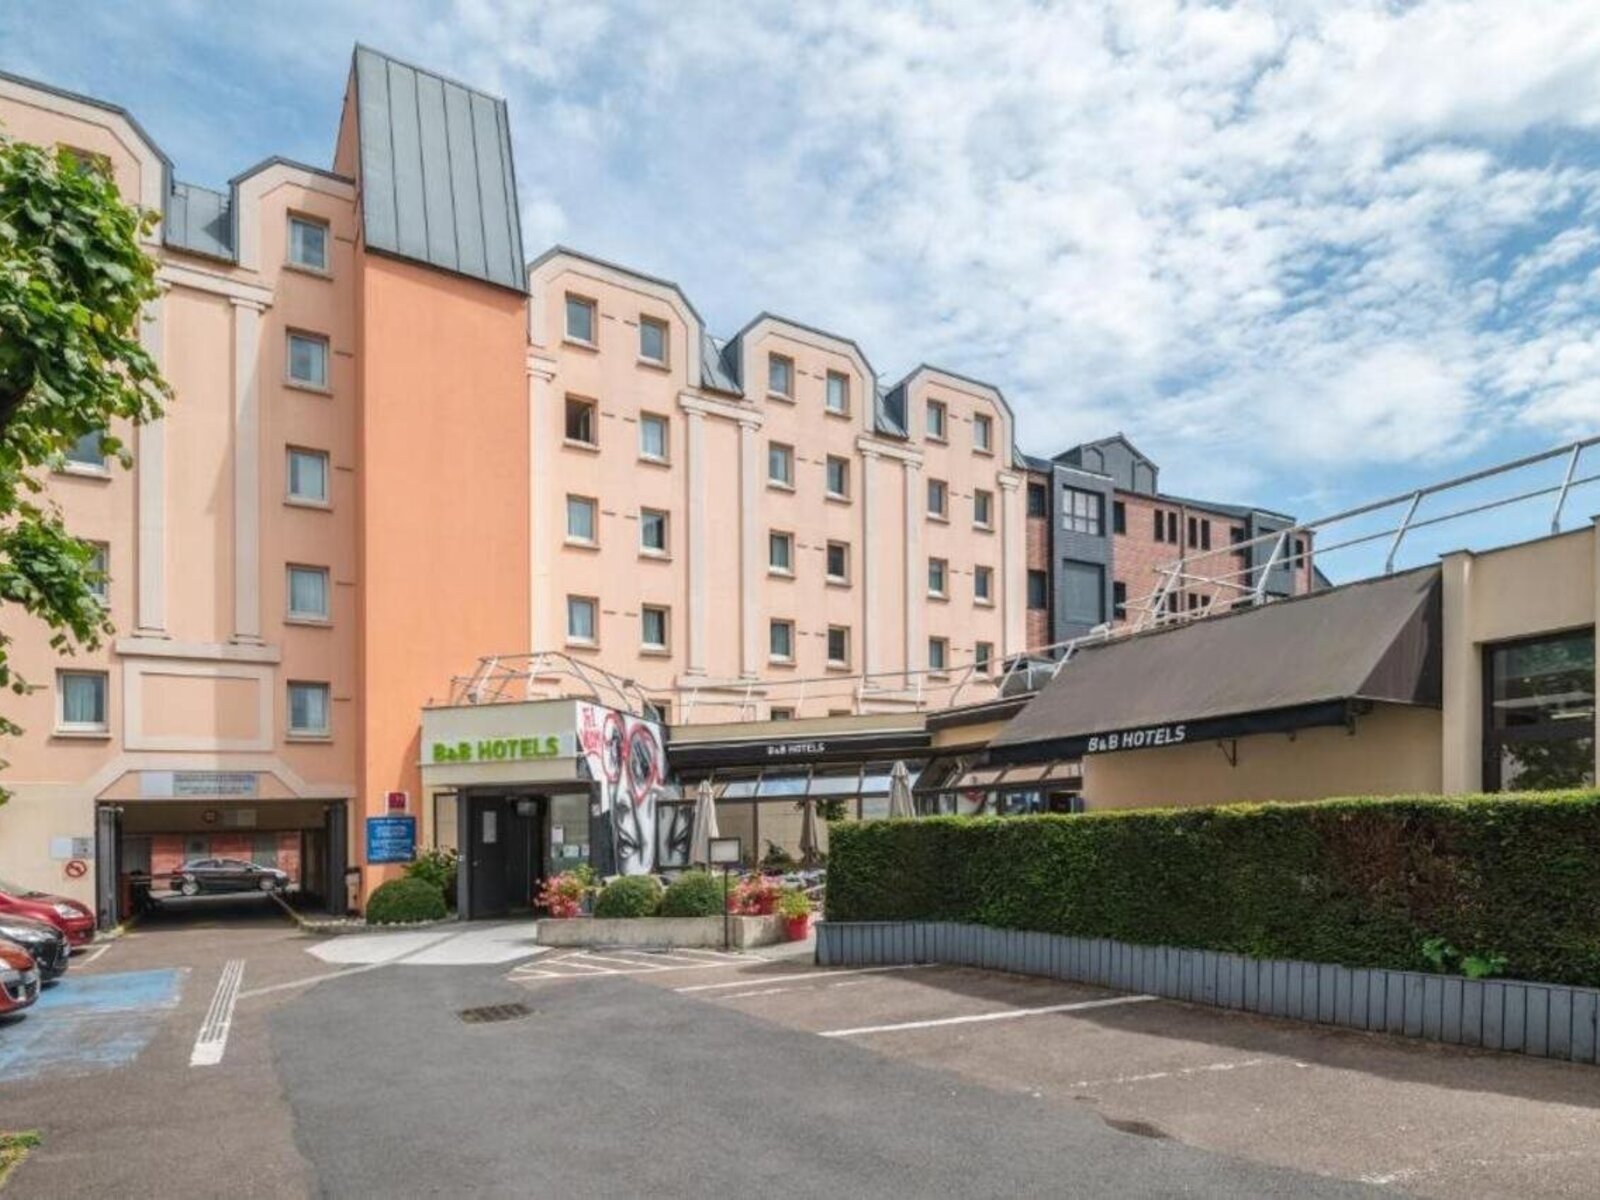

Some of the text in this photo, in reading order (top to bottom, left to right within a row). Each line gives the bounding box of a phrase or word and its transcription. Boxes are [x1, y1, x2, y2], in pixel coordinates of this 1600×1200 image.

[433, 735, 560, 762] B&B HOTELS
[788, 742, 825, 754] HOTELS
[1088, 725, 1187, 752] B&B HOTELS
